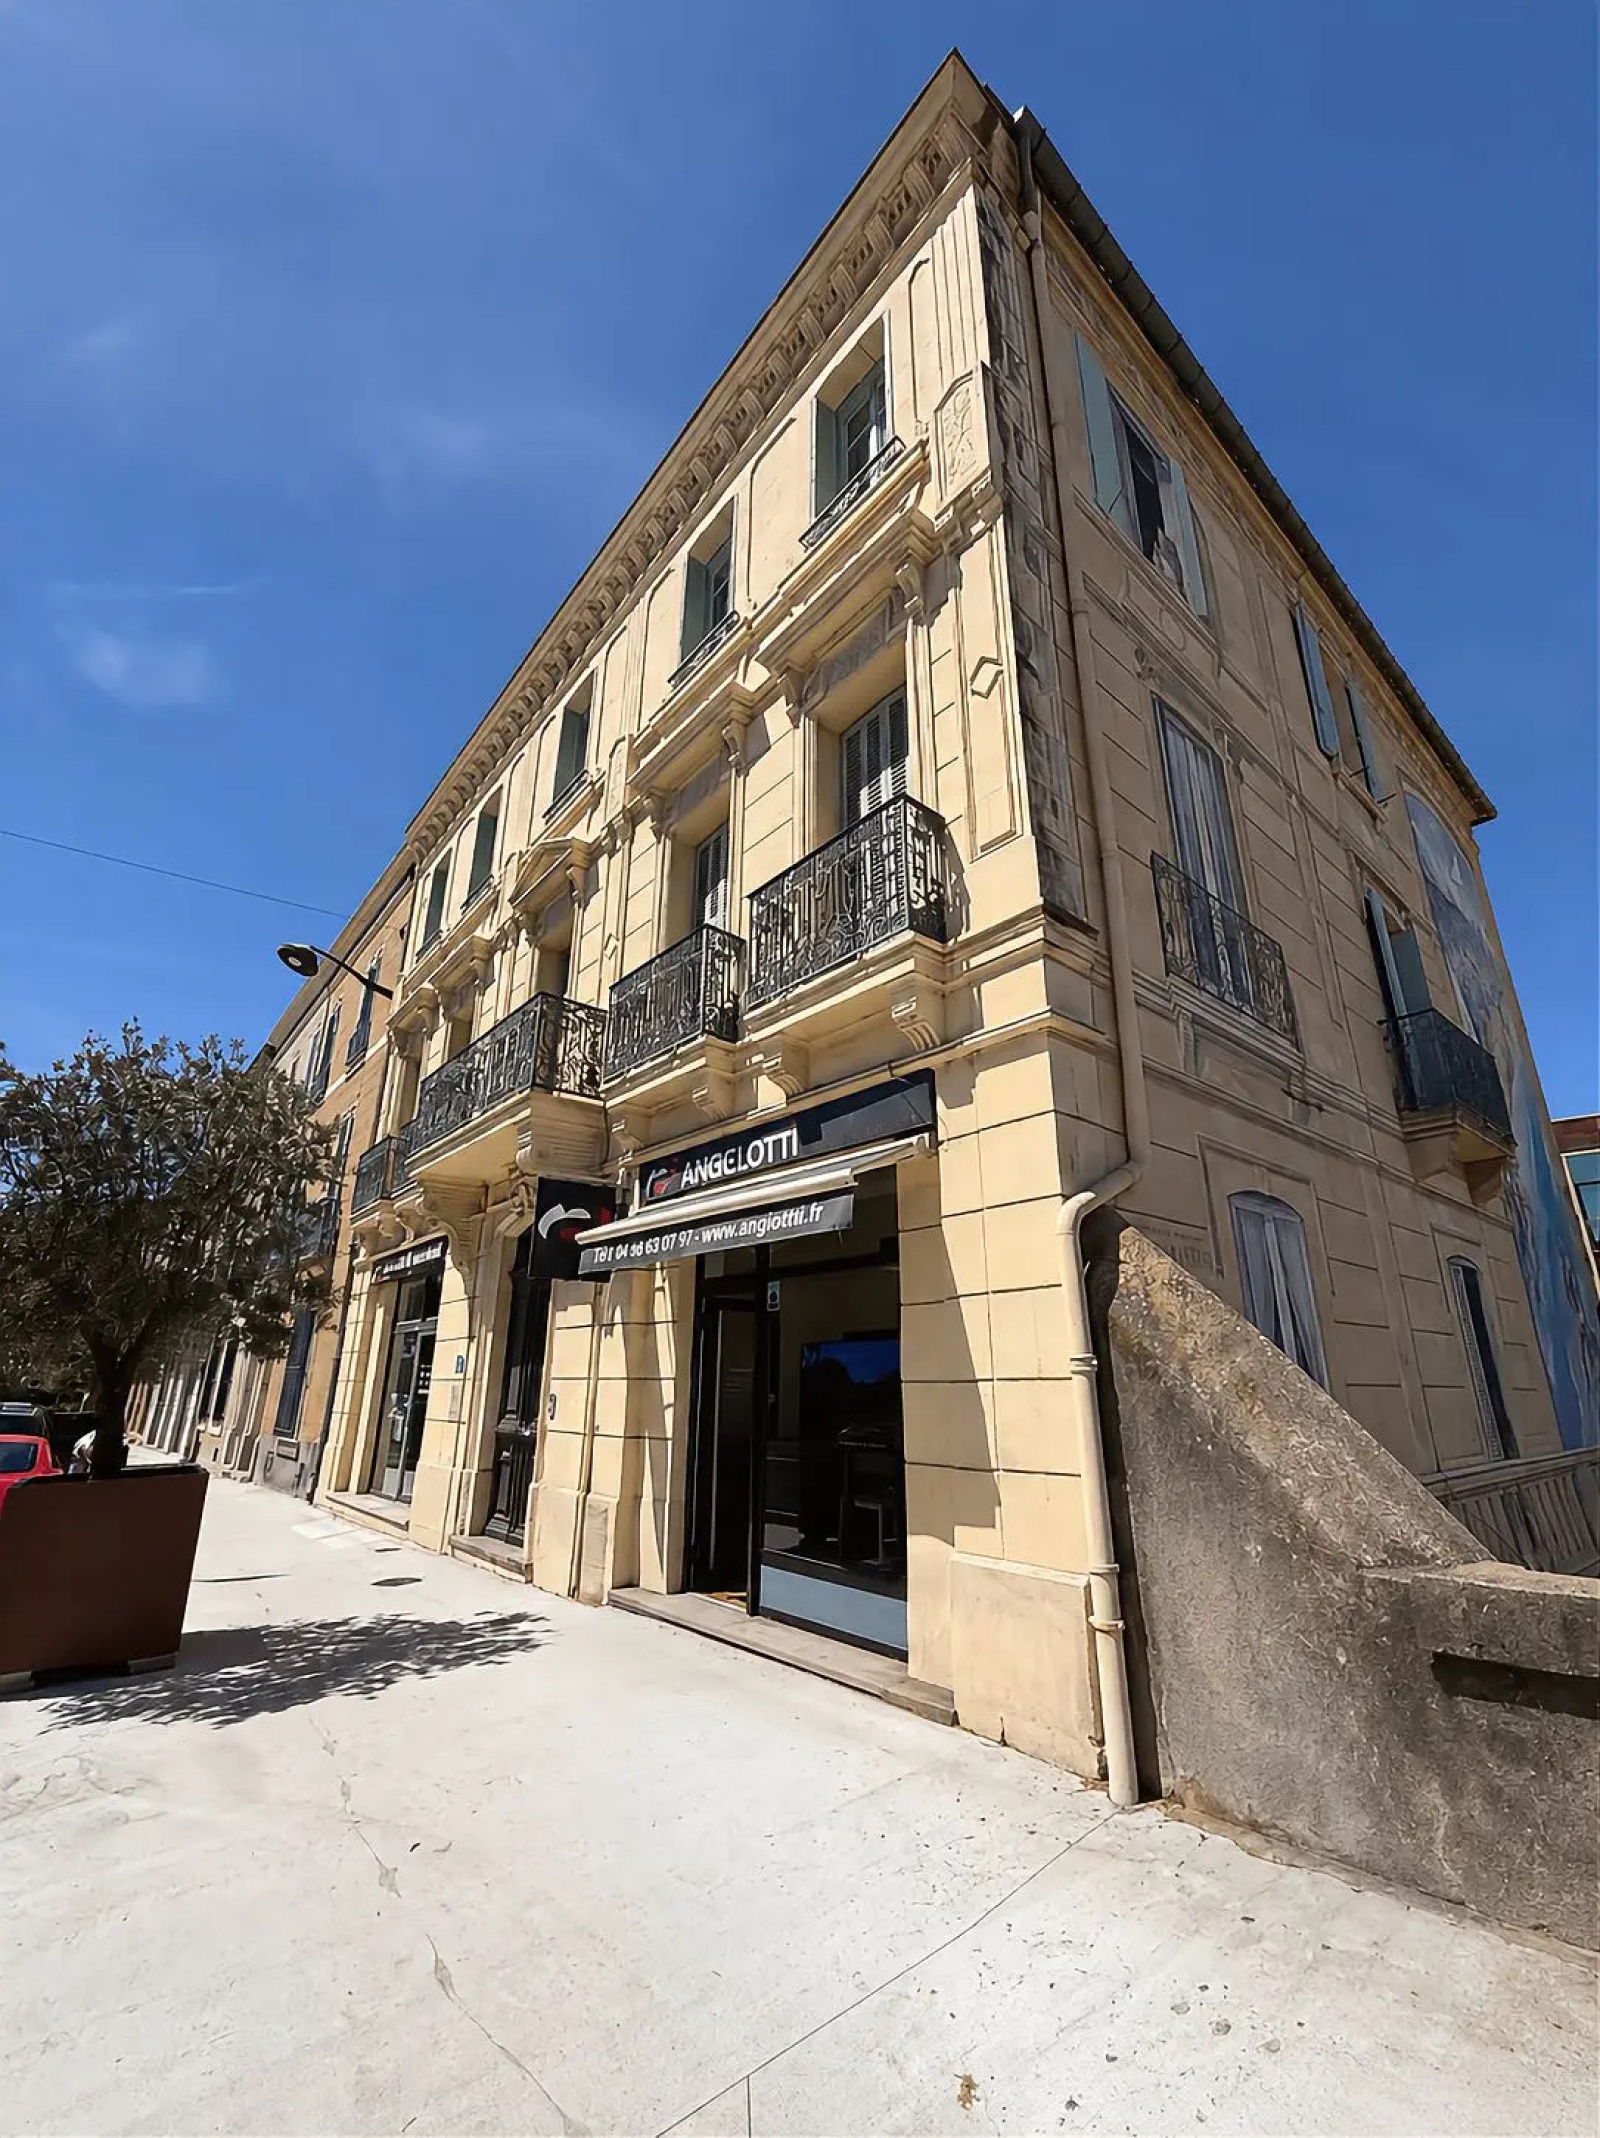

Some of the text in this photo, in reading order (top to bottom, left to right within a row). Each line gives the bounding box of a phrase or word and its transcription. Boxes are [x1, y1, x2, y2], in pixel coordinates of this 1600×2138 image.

[681, 1127, 799, 1189] ANGELOTTI
[645, 1236, 660, 1255] 63
[661, 1232, 677, 1251] 07
[679, 1229, 694, 1247] 97
